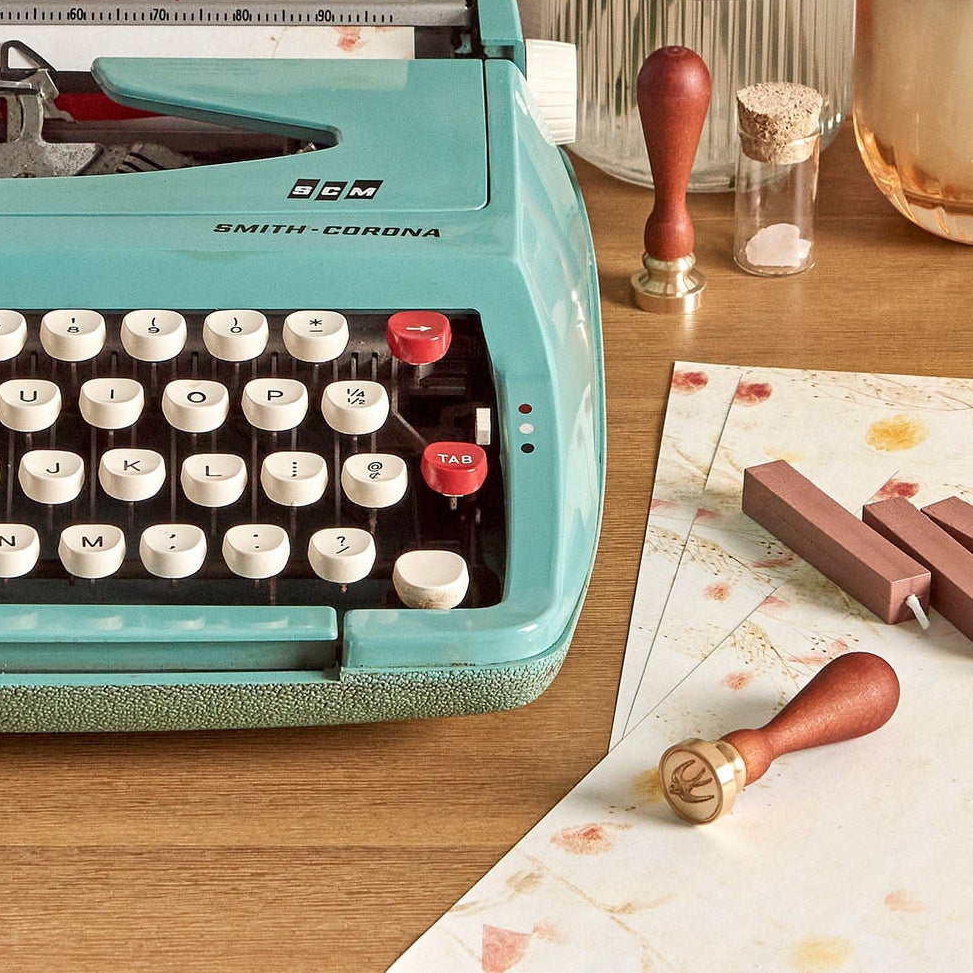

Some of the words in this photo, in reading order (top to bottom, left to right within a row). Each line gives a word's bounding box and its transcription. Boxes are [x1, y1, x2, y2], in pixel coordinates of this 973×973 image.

[70, 8, 84, 21] 60
[153, 8, 167, 21] 70
[235, 9, 249, 22] 80
[318, 9, 332, 22] 90
[289, 182, 381, 198] SCM
[19, 390, 38, 403] U
[186, 391, 207, 404] O
[266, 389, 284, 402] P
[437, 453, 473, 464] TAB
